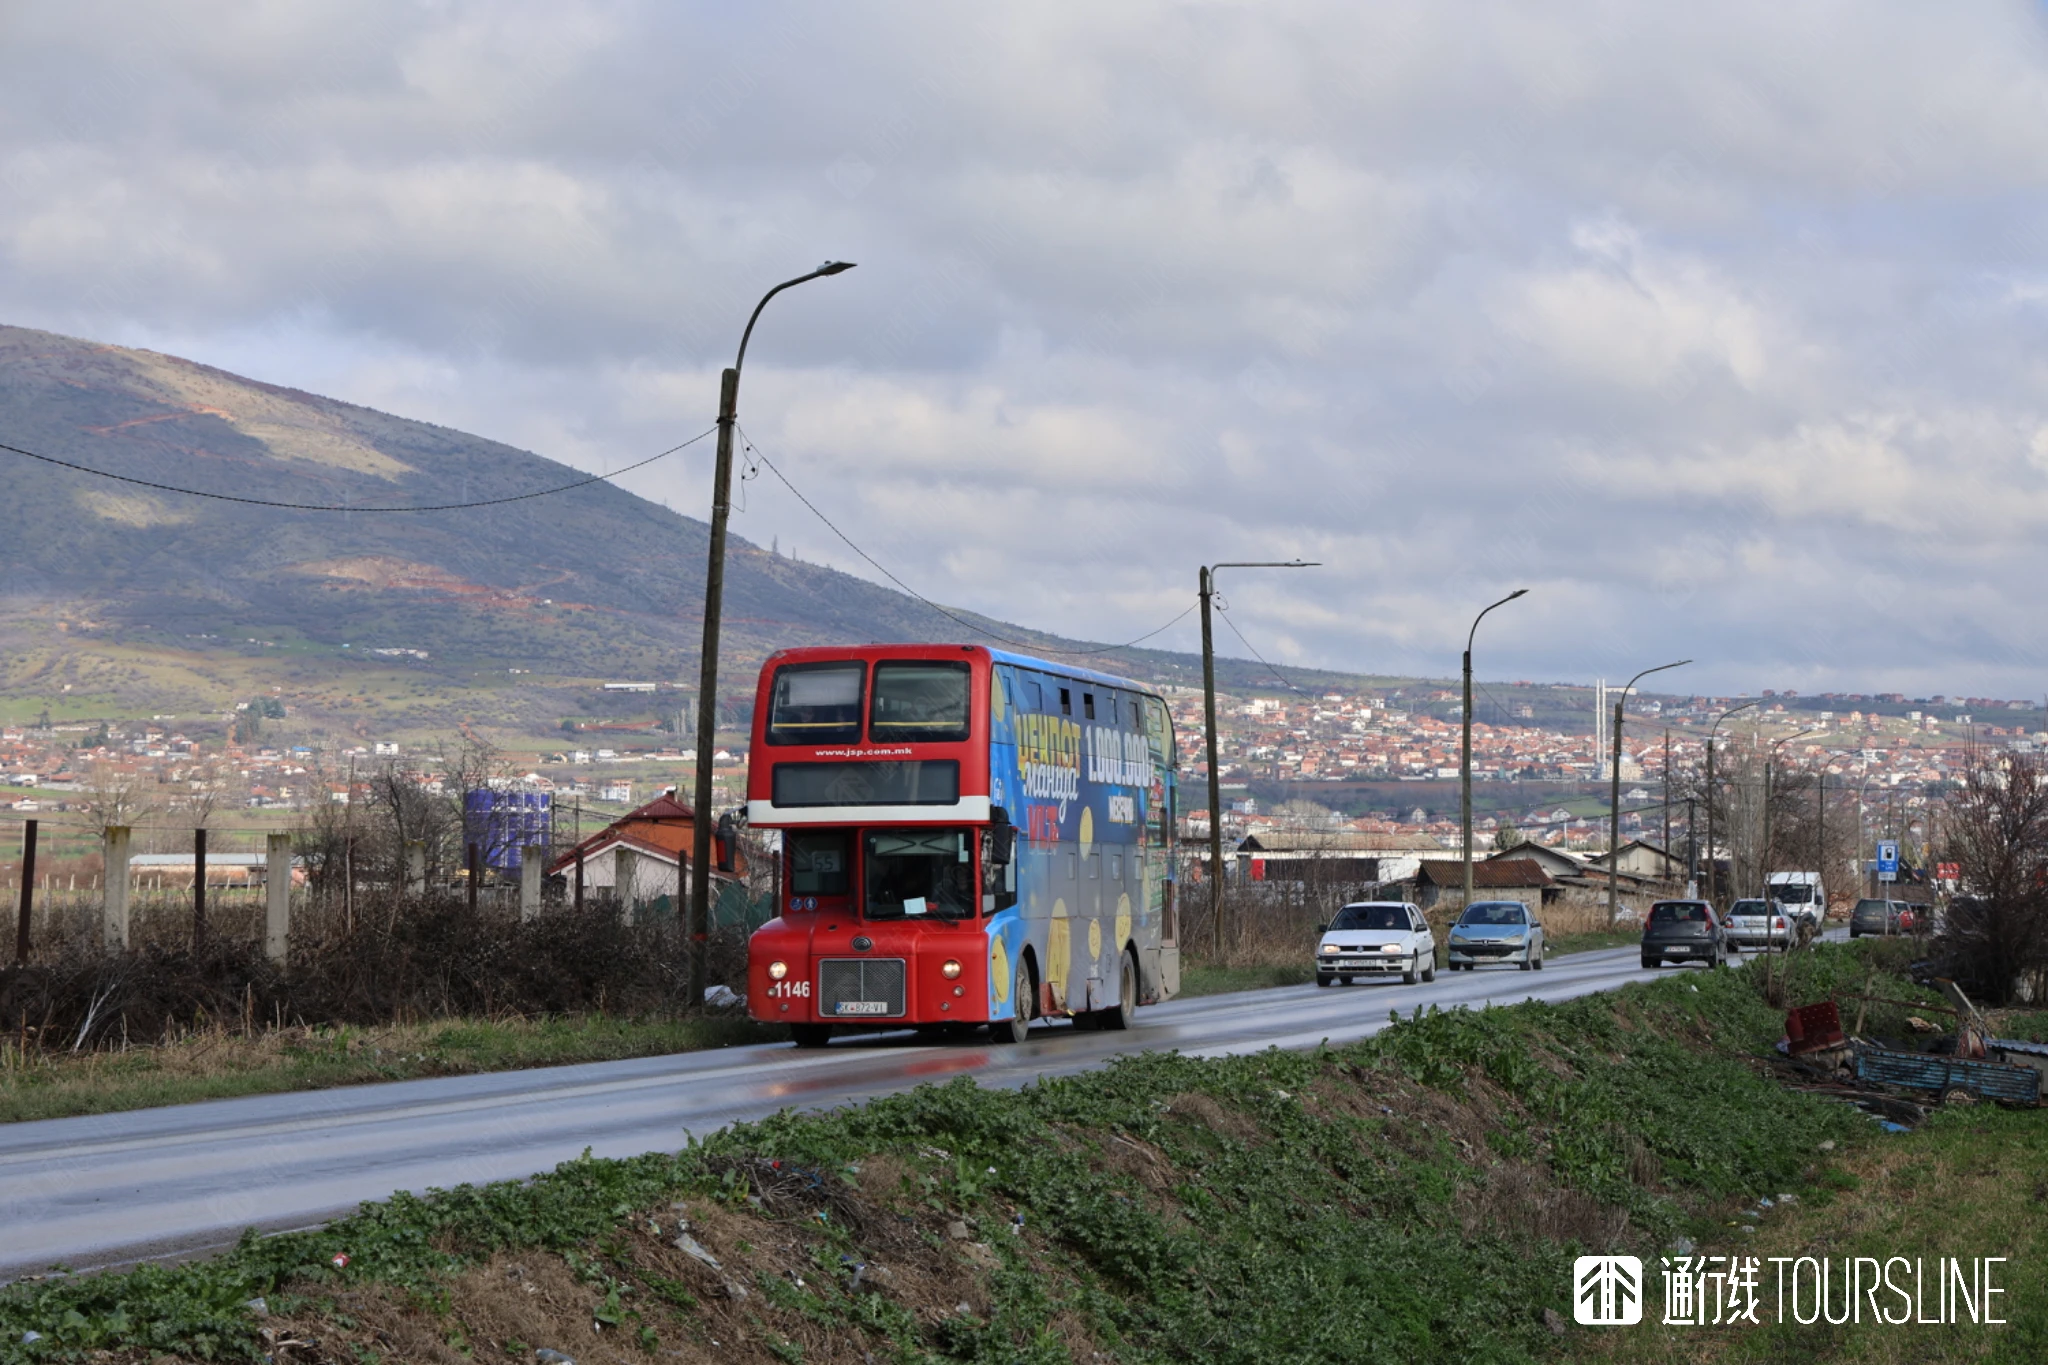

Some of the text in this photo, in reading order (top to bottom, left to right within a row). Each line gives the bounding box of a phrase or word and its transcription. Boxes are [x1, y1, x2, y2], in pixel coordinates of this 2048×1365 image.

[815, 747, 912, 757] www.jsp.com.mk
[815, 855, 834, 871] 55
[775, 981, 811, 998] 1146
